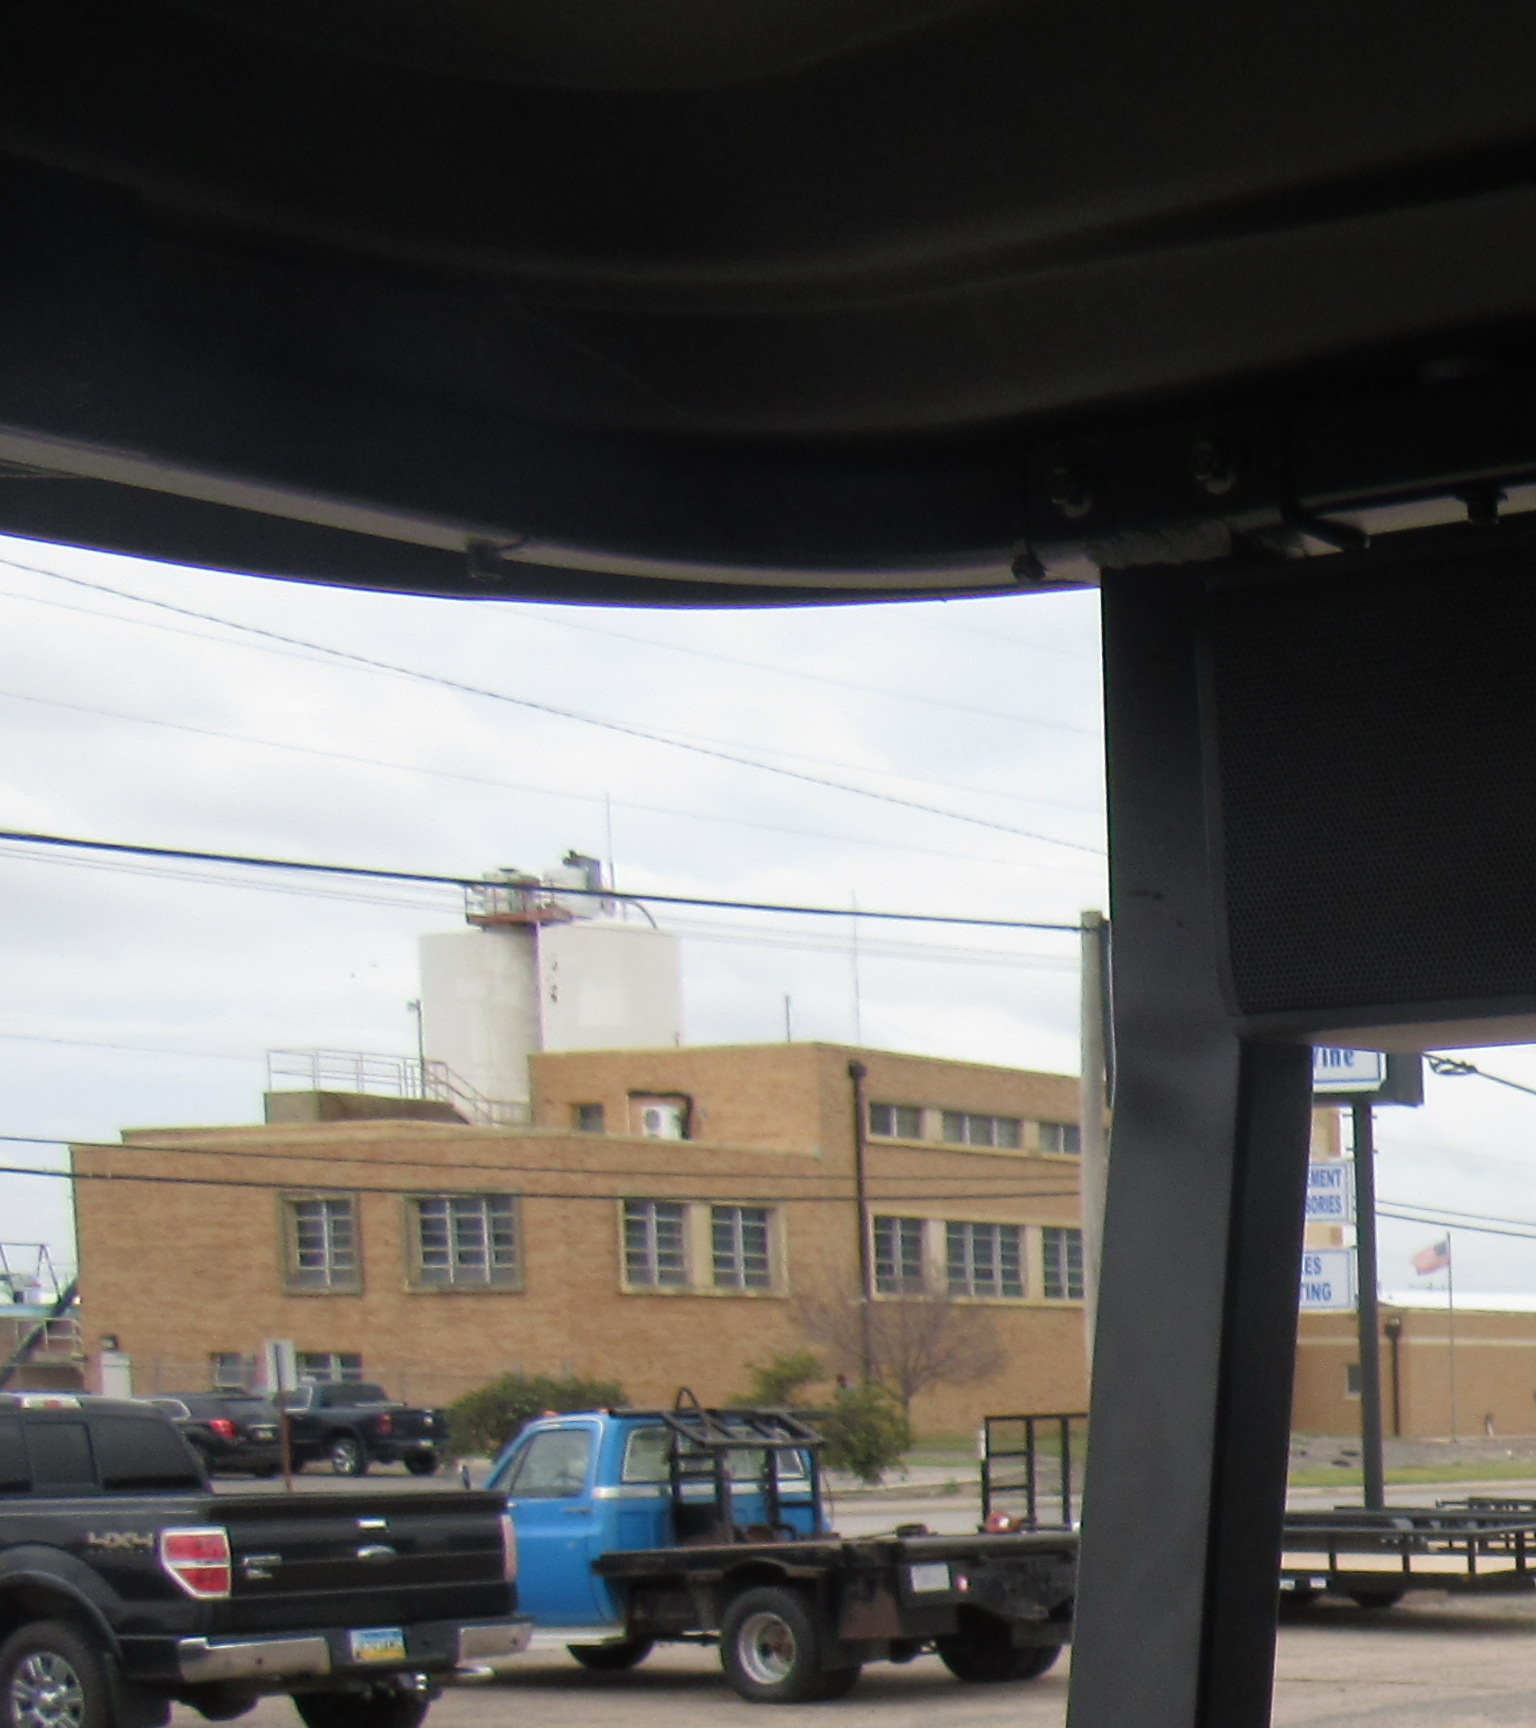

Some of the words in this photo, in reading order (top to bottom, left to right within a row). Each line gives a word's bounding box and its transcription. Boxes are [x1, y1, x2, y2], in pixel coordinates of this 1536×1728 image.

[1313, 1046, 1354, 1067] ine
[1308, 1169, 1342, 1188] MENT
[1303, 1256, 1322, 1275] ES
